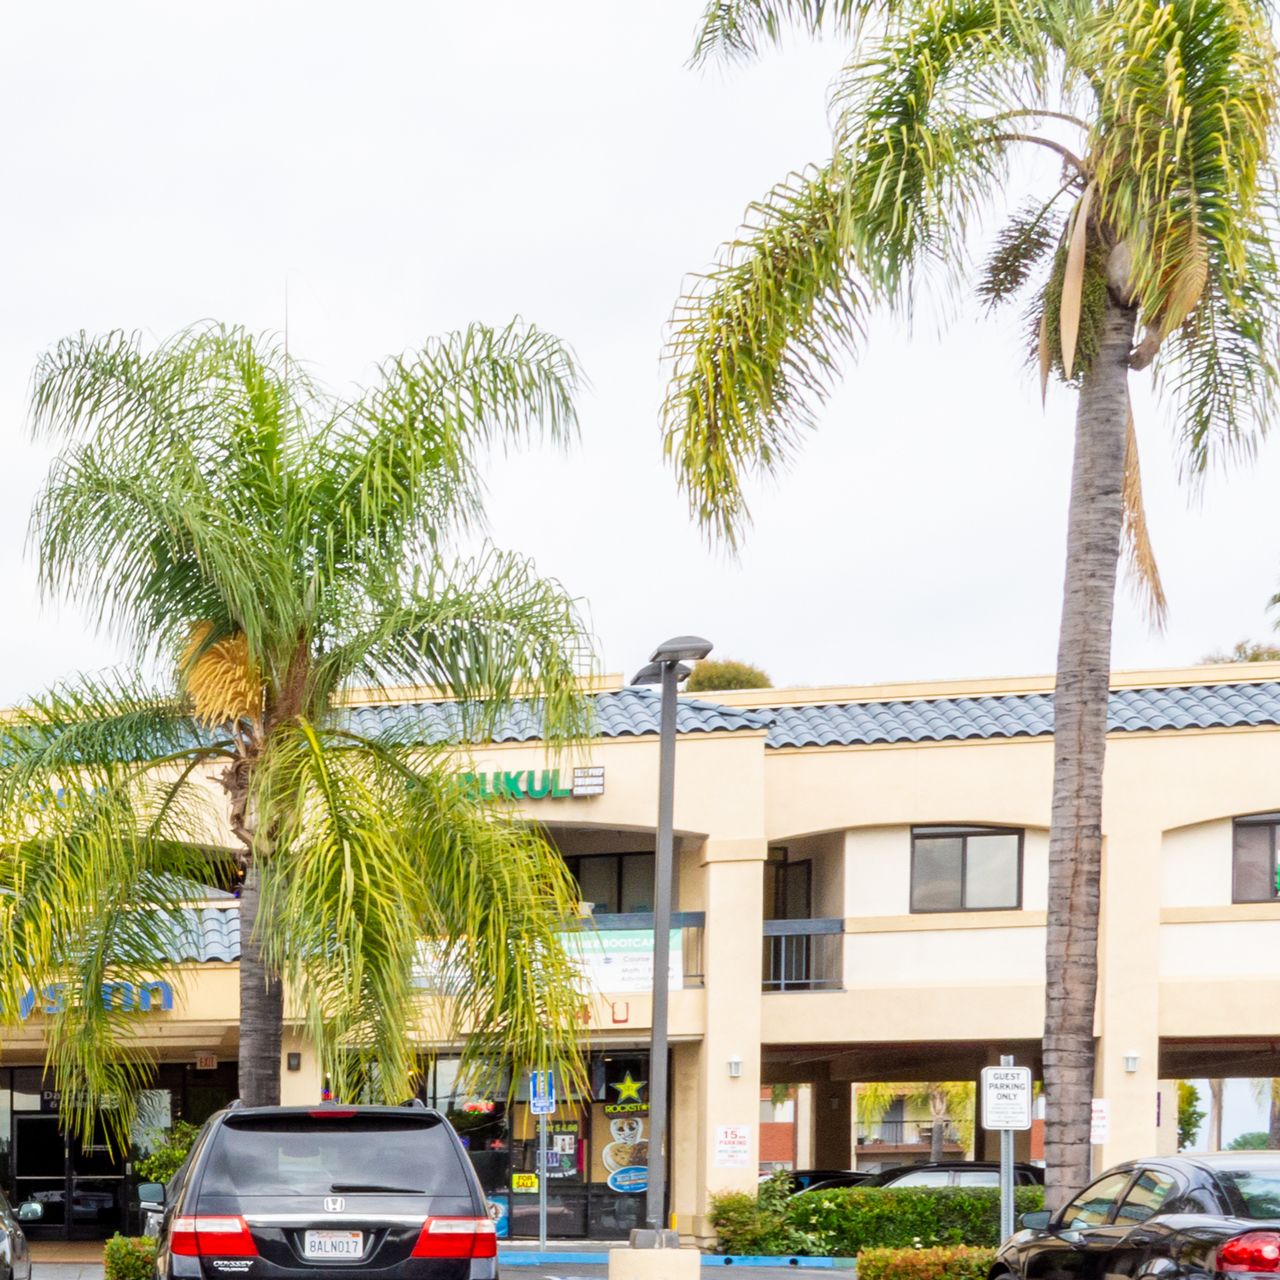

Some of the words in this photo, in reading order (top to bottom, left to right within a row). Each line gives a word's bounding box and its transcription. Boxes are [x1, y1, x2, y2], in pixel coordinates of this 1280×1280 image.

[612, 1003, 628, 1023] U
[723, 1131, 738, 1139] 15
[310, 1241, 358, 1253] 8ALN017
